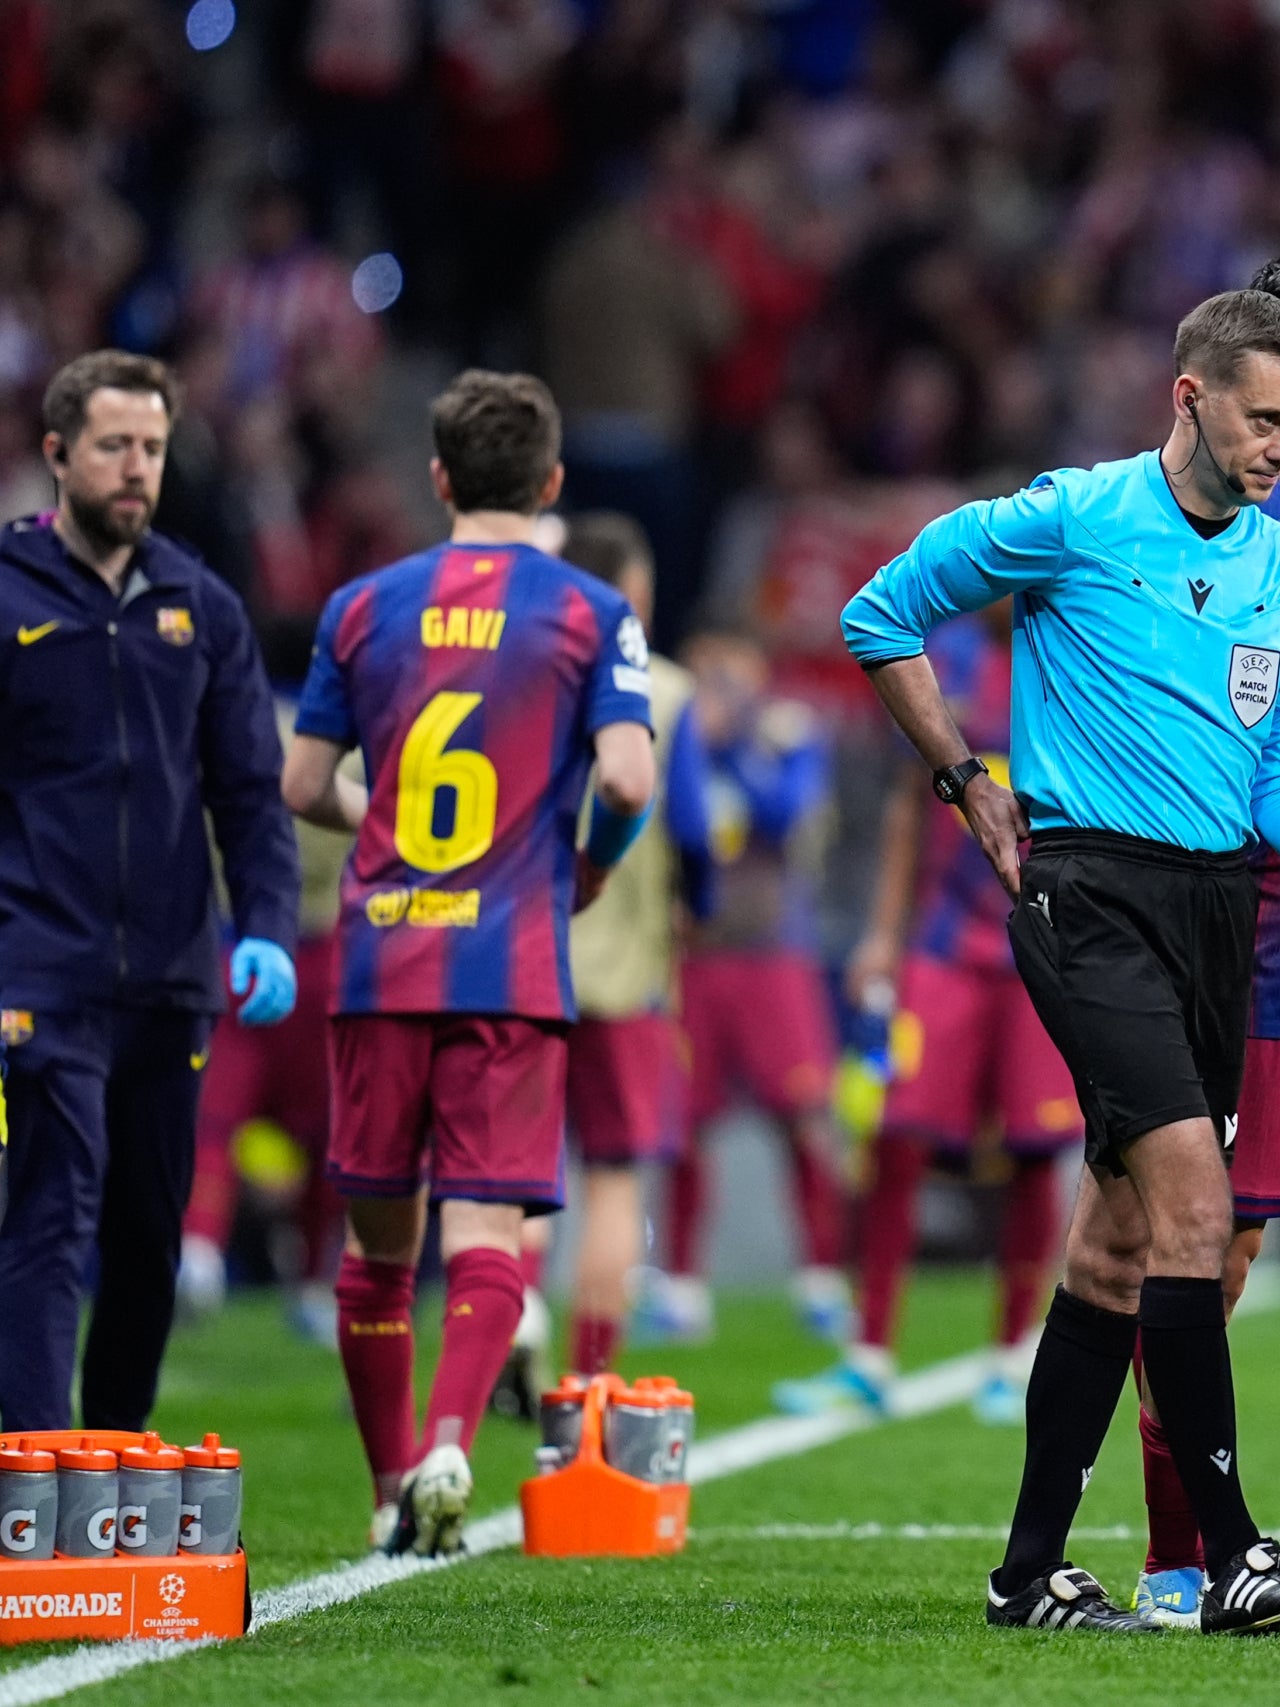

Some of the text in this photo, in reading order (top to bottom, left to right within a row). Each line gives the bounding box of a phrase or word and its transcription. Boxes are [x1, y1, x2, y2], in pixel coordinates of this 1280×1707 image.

[421, 606, 506, 650] GAVI
[1242, 656, 1269, 673] UEFA
[1235, 691, 1268, 705] OFFICIAL
[1240, 680, 1267, 692] MATCH
[395, 692, 498, 873] 6
[0, 1509, 36, 1552] G
[87, 1507, 117, 1551] G
[117, 1505, 147, 1548] G
[0, 1593, 122, 1619] ATORADE
[143, 1617, 199, 1628] CHAMPIONS
